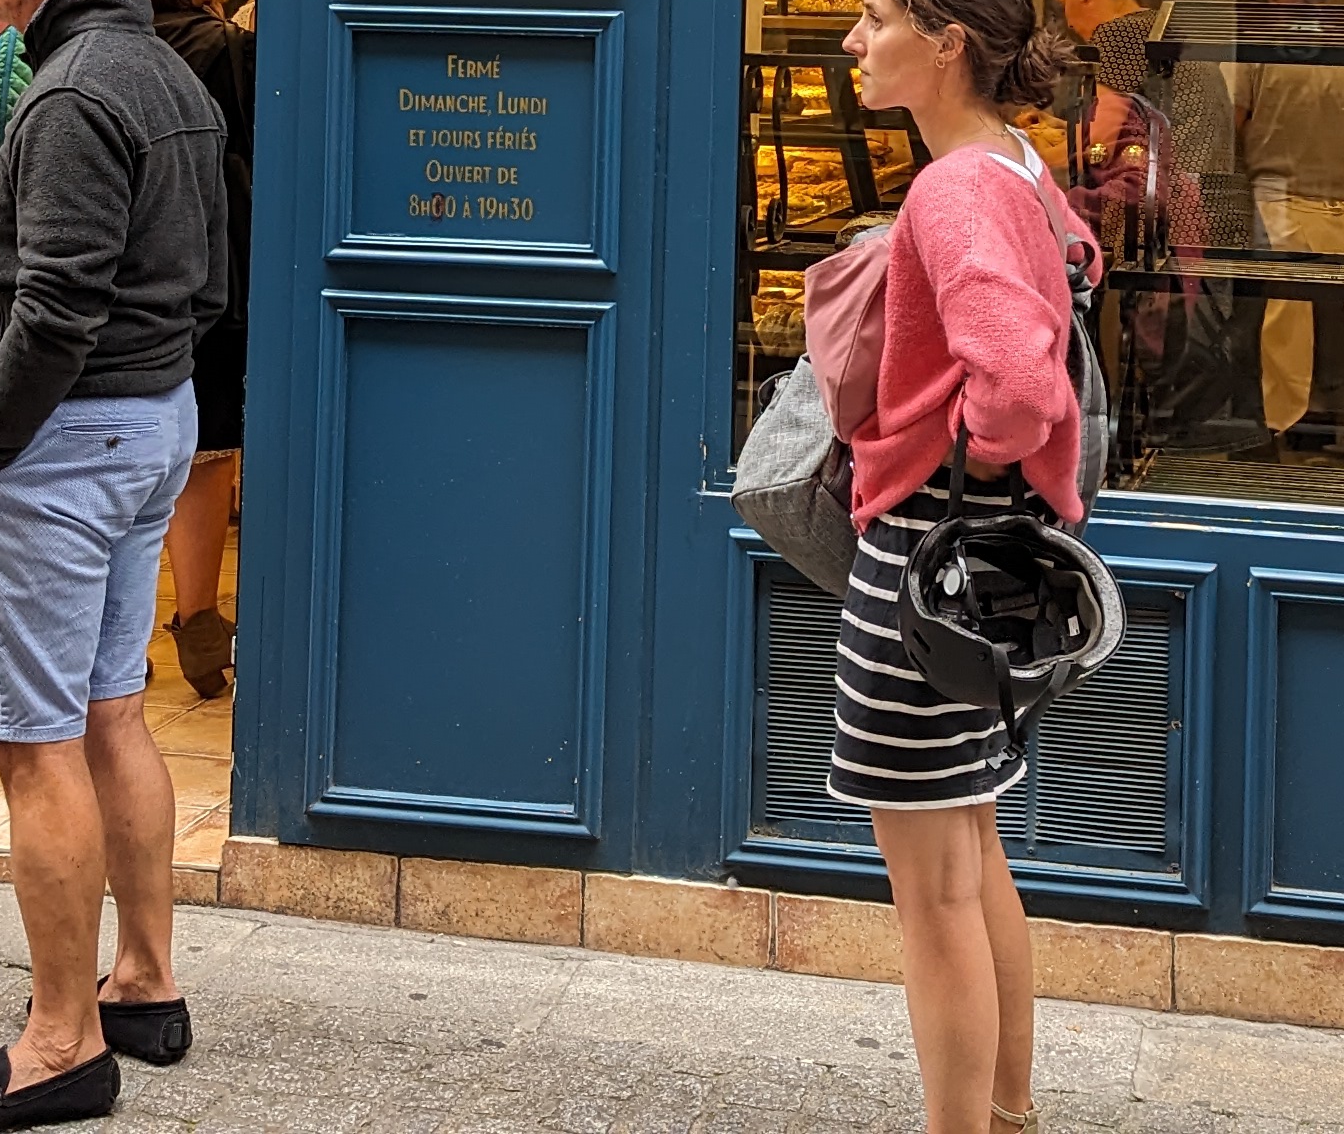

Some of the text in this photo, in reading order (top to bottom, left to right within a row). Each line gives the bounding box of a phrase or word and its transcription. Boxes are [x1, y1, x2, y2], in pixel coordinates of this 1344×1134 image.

[497, 91, 548, 115] LUNDI
[409, 126, 537, 151] ET JOURS FÉRIÉS
[425, 160, 518, 185] OUVERT DE
